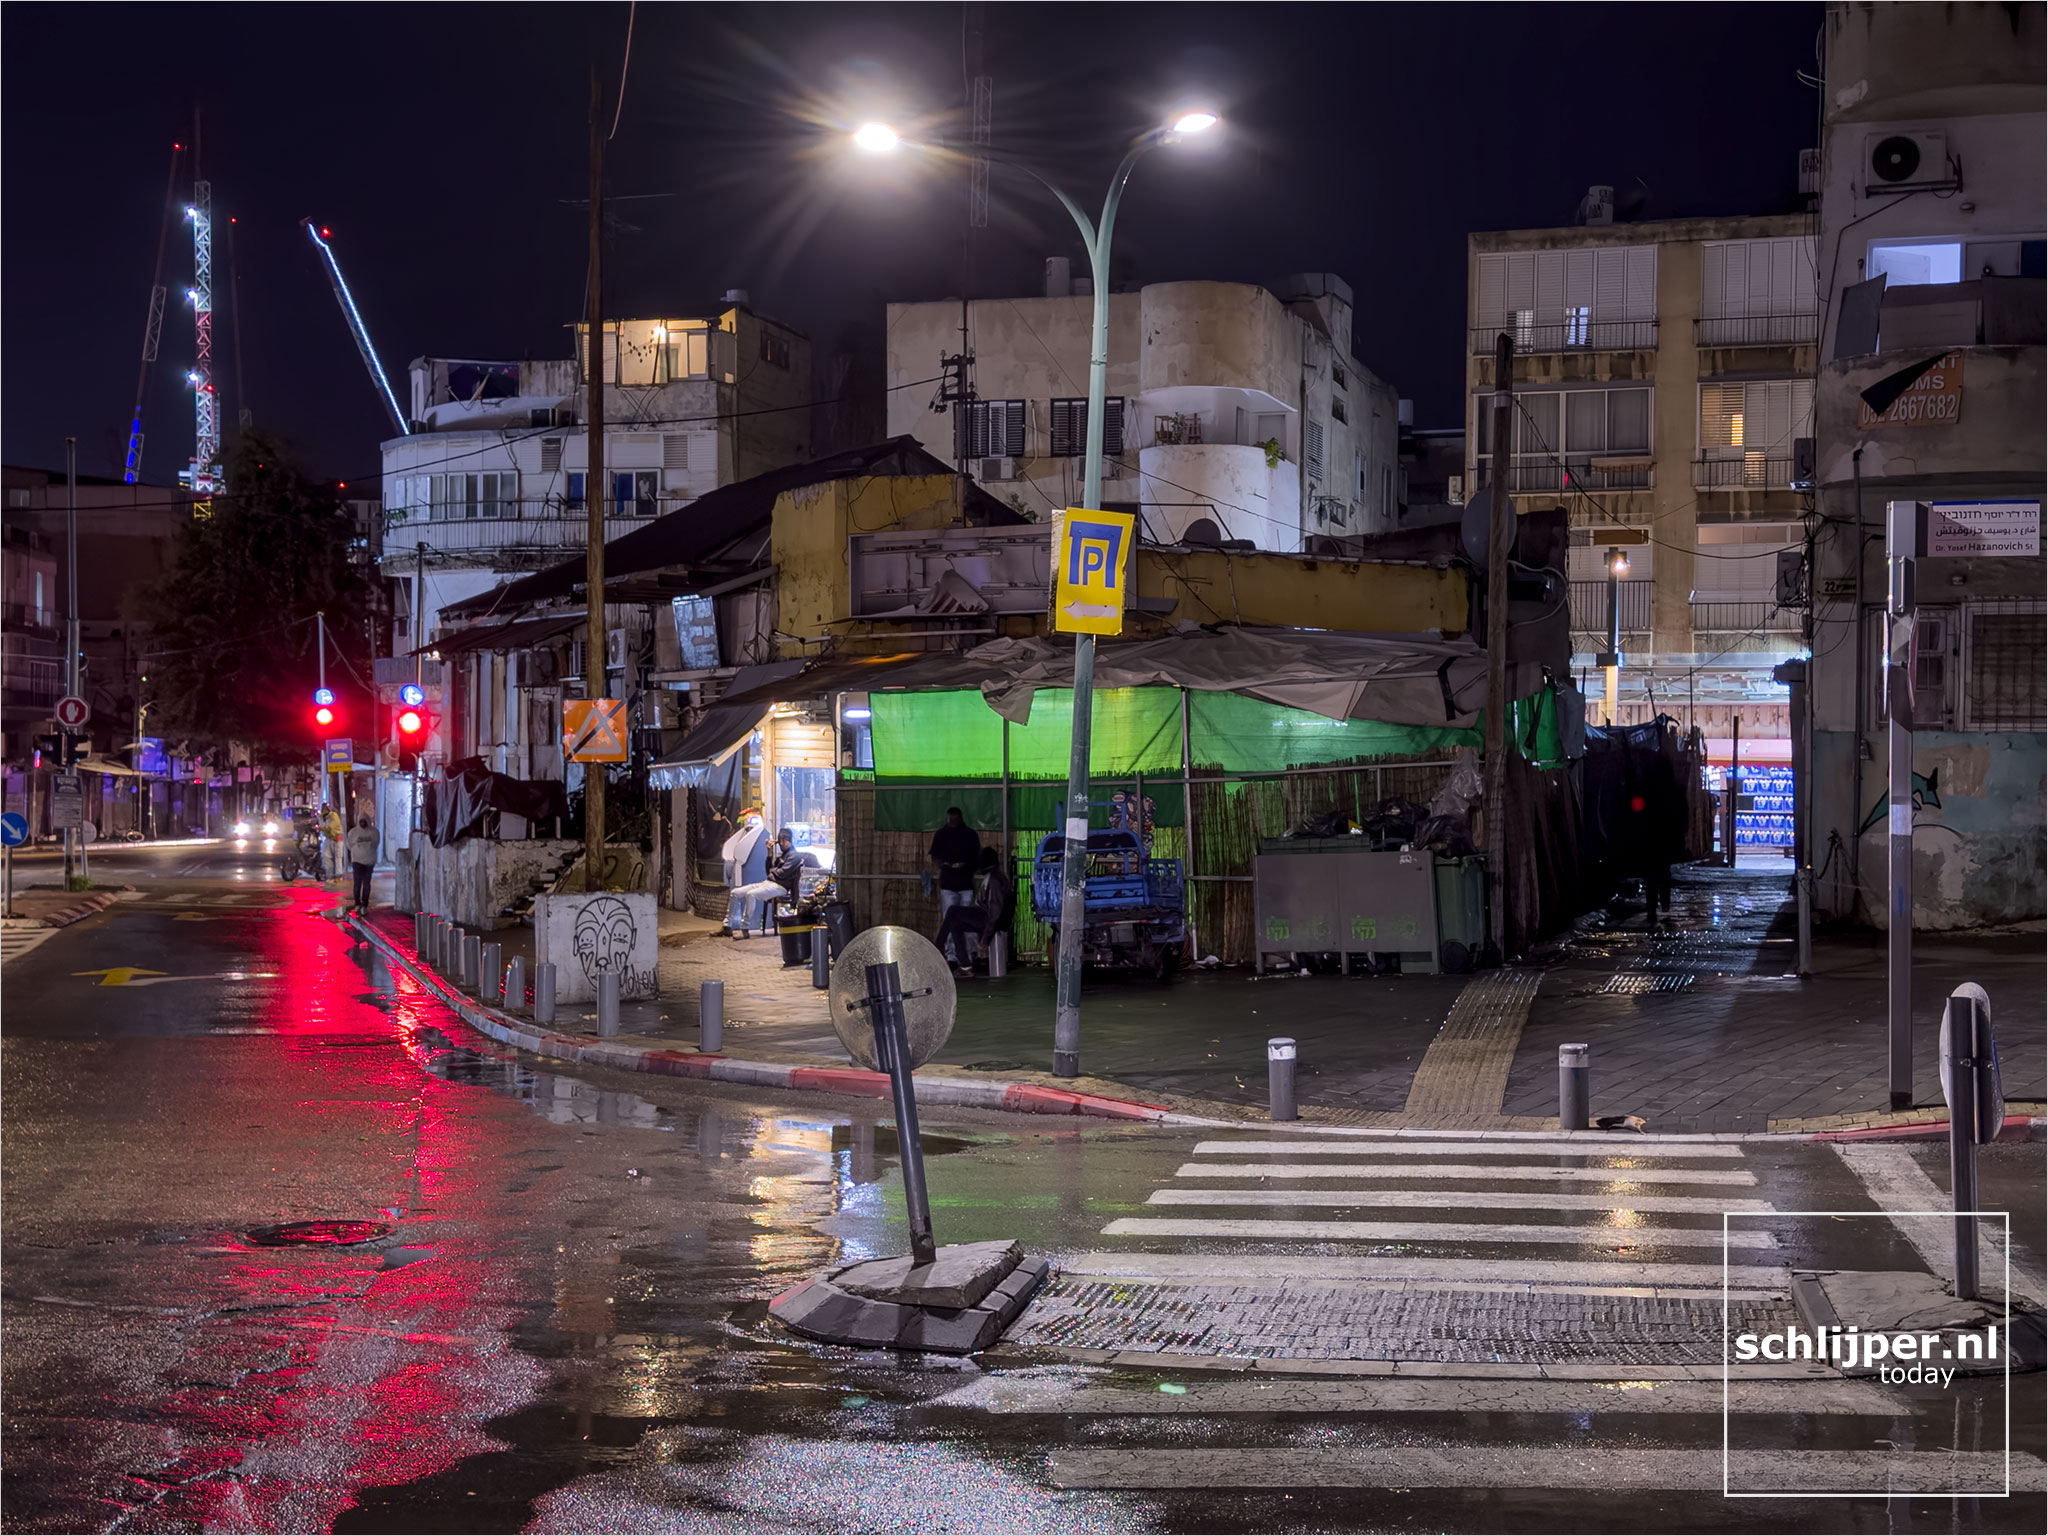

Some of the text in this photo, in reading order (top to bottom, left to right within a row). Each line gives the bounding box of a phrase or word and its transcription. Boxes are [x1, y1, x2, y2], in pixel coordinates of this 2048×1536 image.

[1983, 511, 2004, 520] יוסף
[2020, 525, 2036, 535] شارع
[1935, 544, 1946, 552] Dr.
[1948, 544, 1967, 552] Yosef
[1968, 541, 2023, 551] Hazanovich
